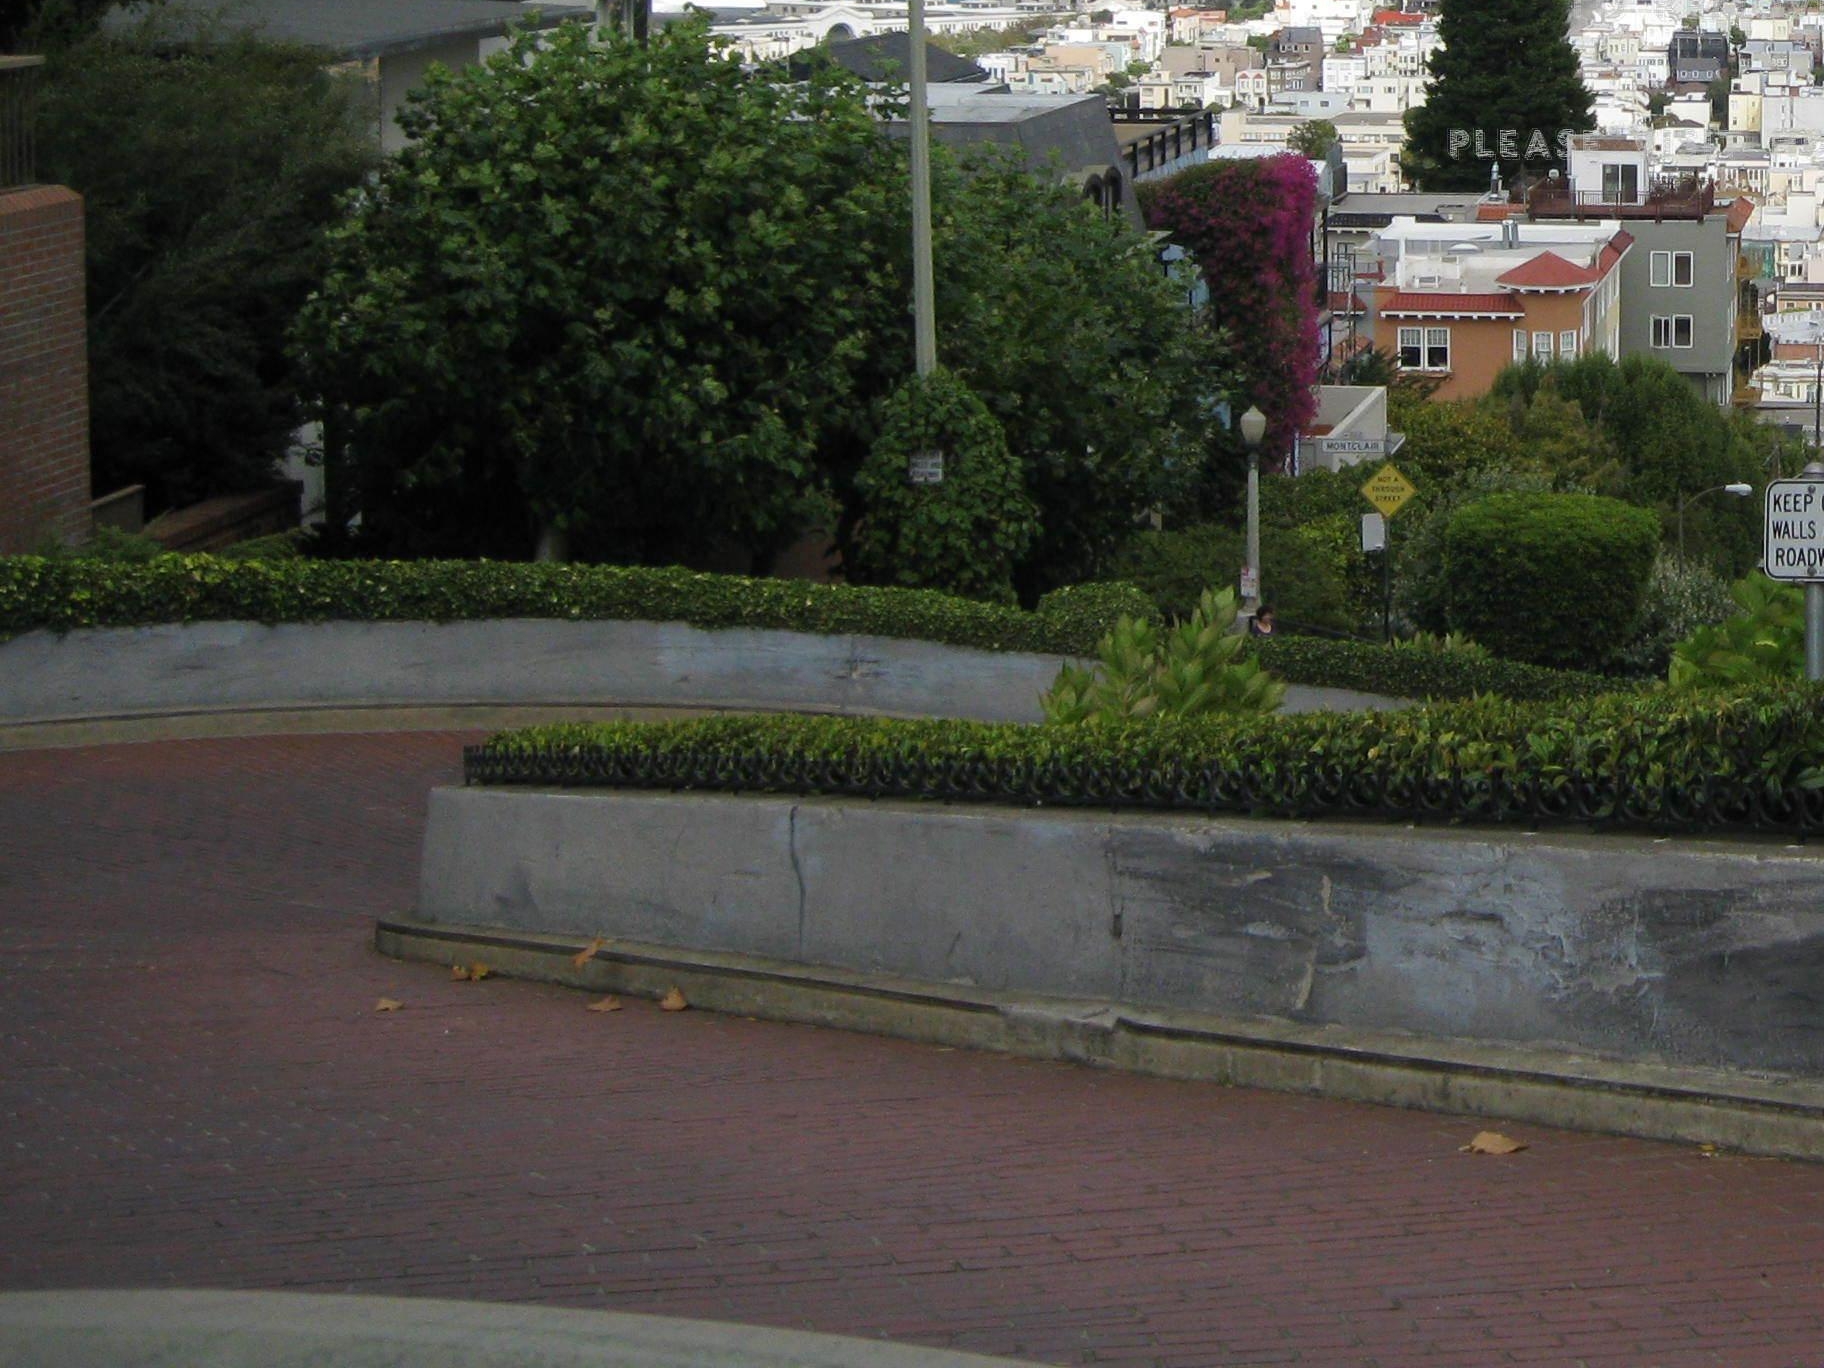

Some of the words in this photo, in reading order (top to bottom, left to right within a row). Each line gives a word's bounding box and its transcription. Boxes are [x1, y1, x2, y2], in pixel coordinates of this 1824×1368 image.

[1326, 442, 1379, 450] MONTCLAIR
[1773, 493, 1814, 513] KEEP
[1772, 520, 1817, 540] WALLS
